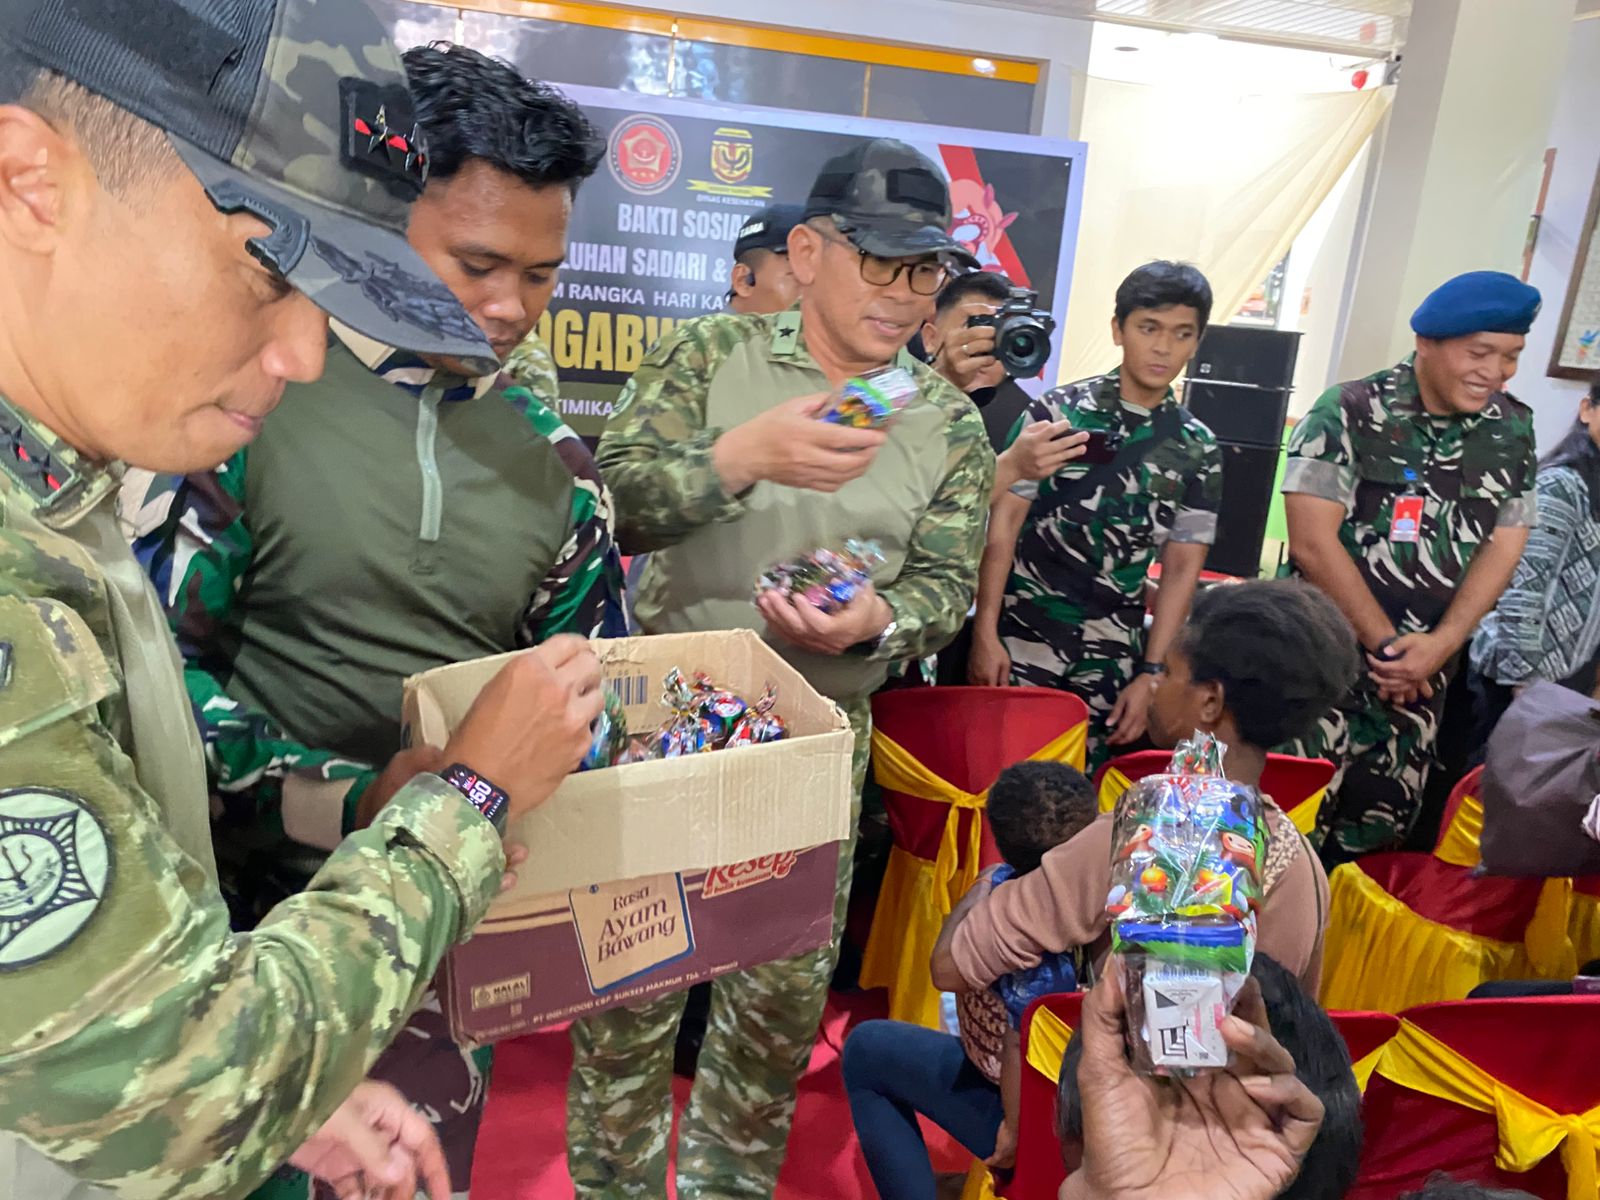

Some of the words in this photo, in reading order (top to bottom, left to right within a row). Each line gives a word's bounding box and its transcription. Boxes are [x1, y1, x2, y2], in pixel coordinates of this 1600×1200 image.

[617, 203, 677, 236] BAKTI
[632, 247, 707, 281] SADARI
[711, 257, 727, 283] &
[568, 283, 645, 305] RANGKA
[653, 291, 697, 308] HARI
[558, 398, 613, 416] IMIKA
[613, 886, 649, 911] Rasa
[600, 898, 667, 941] Ayam
[598, 915, 675, 963] Bawang
[613, 987, 645, 1001] SUKSES
[646, 976, 682, 992] MAKMUR
